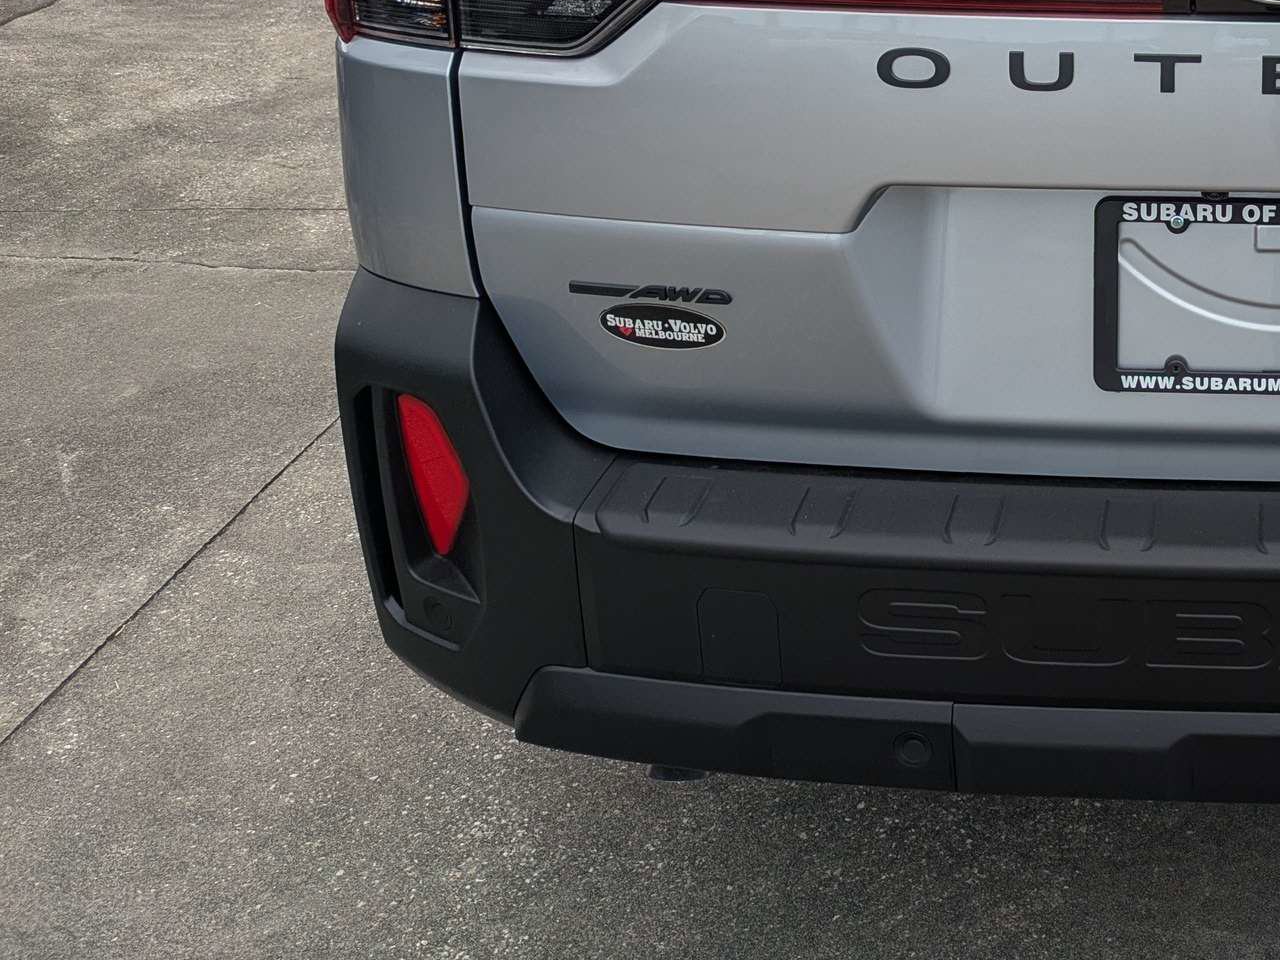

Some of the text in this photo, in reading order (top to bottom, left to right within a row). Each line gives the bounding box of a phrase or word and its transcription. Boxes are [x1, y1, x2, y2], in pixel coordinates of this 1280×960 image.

[1122, 202, 1233, 223] SUBARU
[1242, 204, 1277, 224] OF
[629, 285, 733, 305] AWD
[635, 327, 706, 343] MELBOURNE
